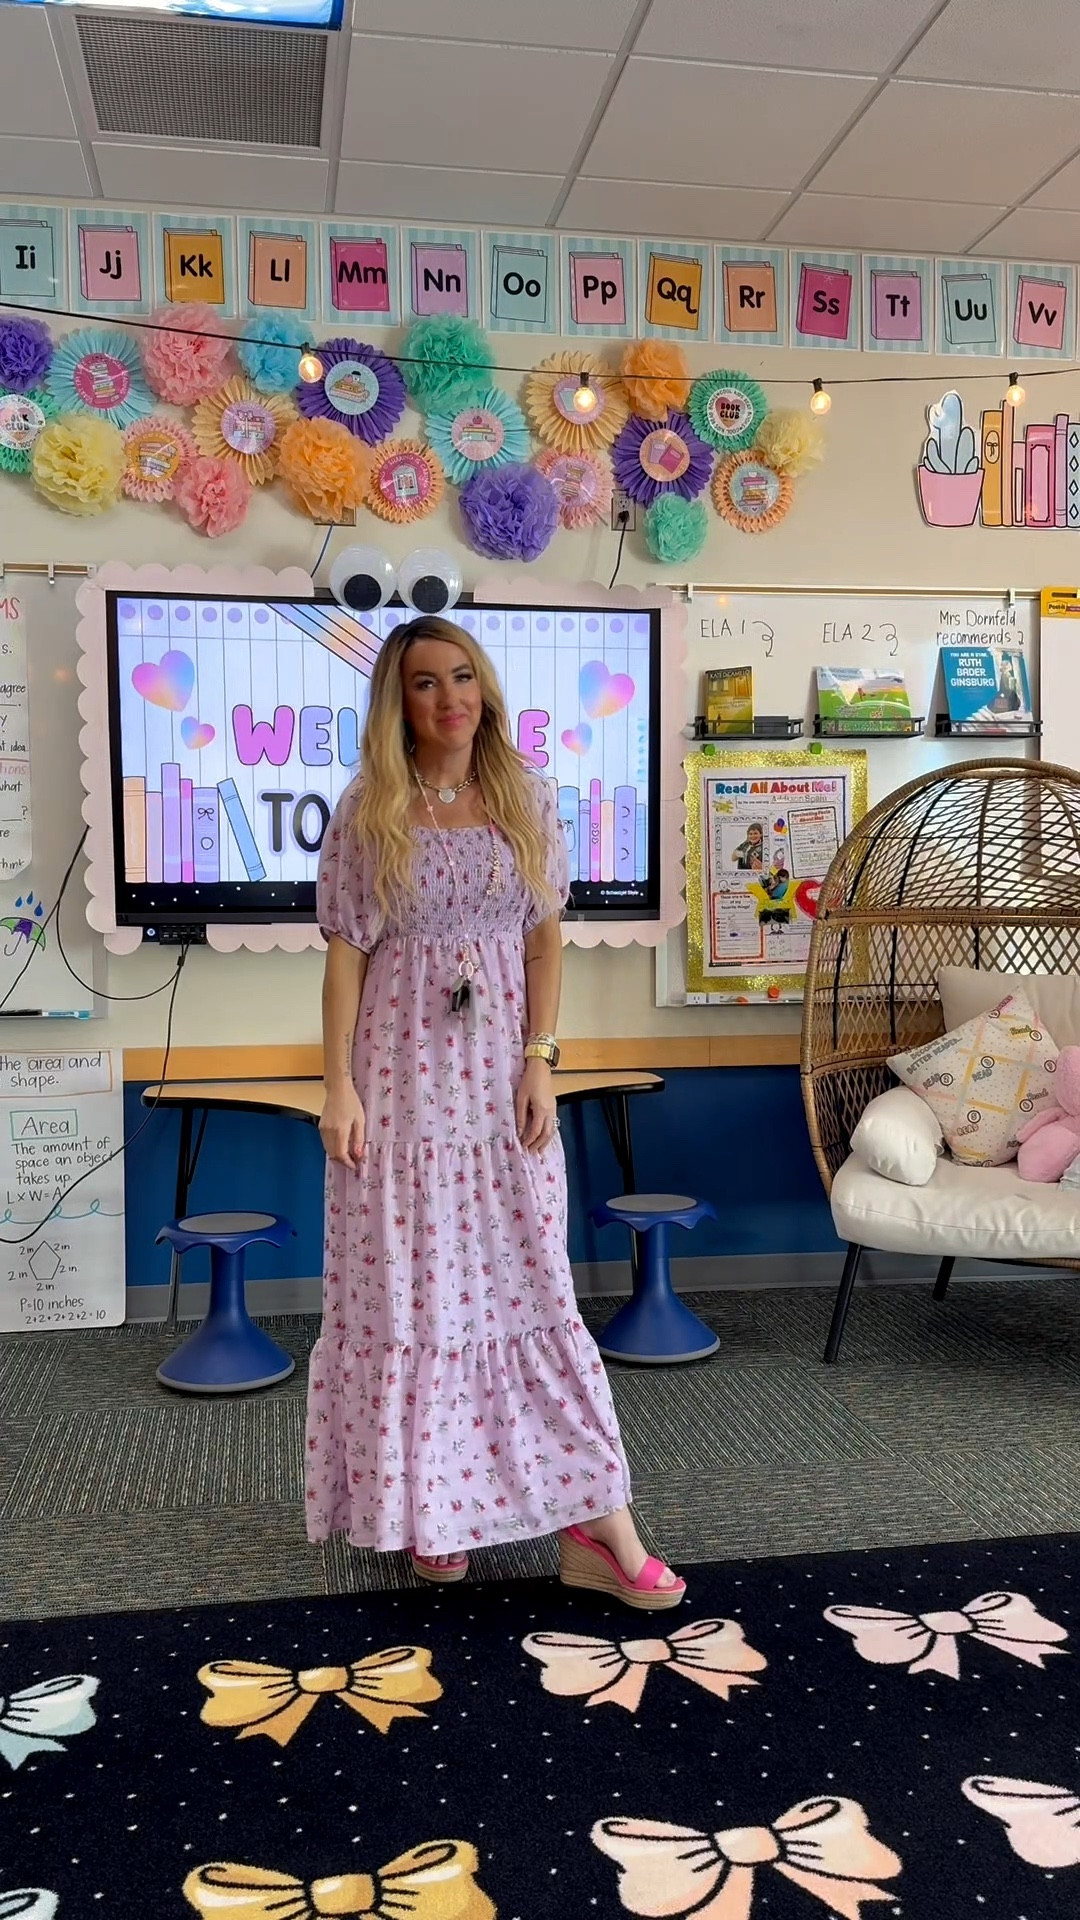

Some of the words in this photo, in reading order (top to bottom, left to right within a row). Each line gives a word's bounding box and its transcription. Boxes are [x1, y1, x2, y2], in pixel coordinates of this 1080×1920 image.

[15, 245, 36, 270] Ii
[100, 250, 122, 280] Jj
[180, 254, 213, 278] Kk
[270, 258, 290, 282] Ll
[338, 261, 387, 285] Mm
[423, 268, 461, 293] Nn
[503, 271, 542, 298] Oo
[583, 275, 617, 305] Pp
[657, 277, 698, 314] Qq
[739, 285, 766, 309] Rr
[812, 290, 840, 316] Ss
[886, 294, 911, 317] Tt
[955, 299, 988, 322] Uu
[1028, 301, 1057, 326] Vv
[720, 402, 741, 411] BOOK
[720, 411, 740, 420] CLUB
[5, 422, 30, 431] CLUB
[701, 618, 732, 638] ELA
[741, 619, 746, 634] 1
[939, 609, 961, 627] Mrs
[965, 609, 1016, 627] Dornfeld
[822, 622, 853, 643] ELA
[861, 623, 876, 642] 2
[936, 628, 1012, 646] recommends
[956, 667, 987, 677] BADER
[958, 658, 982, 667] RUTH
[950, 677, 995, 687] GINSBURG
[10, 741, 26, 752] idea
[715, 782, 748, 795] Read
[749, 781, 769, 794] All
[769, 781, 810, 794] About
[811, 780, 837, 793] Me!
[260, 792, 331, 853] TO
[28, 1058, 62, 1071] area
[68, 1050, 102, 1069] and
[10, 1072, 60, 1093] shape.
[21, 1116, 70, 1136] Area
[11, 1142, 36, 1156] The
[42, 1135, 93, 1154] amount
[96, 1136, 111, 1150] of
[15, 1157, 50, 1175] space
[55, 1155, 72, 1166] an
[76, 1150, 114, 1168] object
[16, 1171, 50, 1186] takes
[47, 1294, 85, 1310] inches
